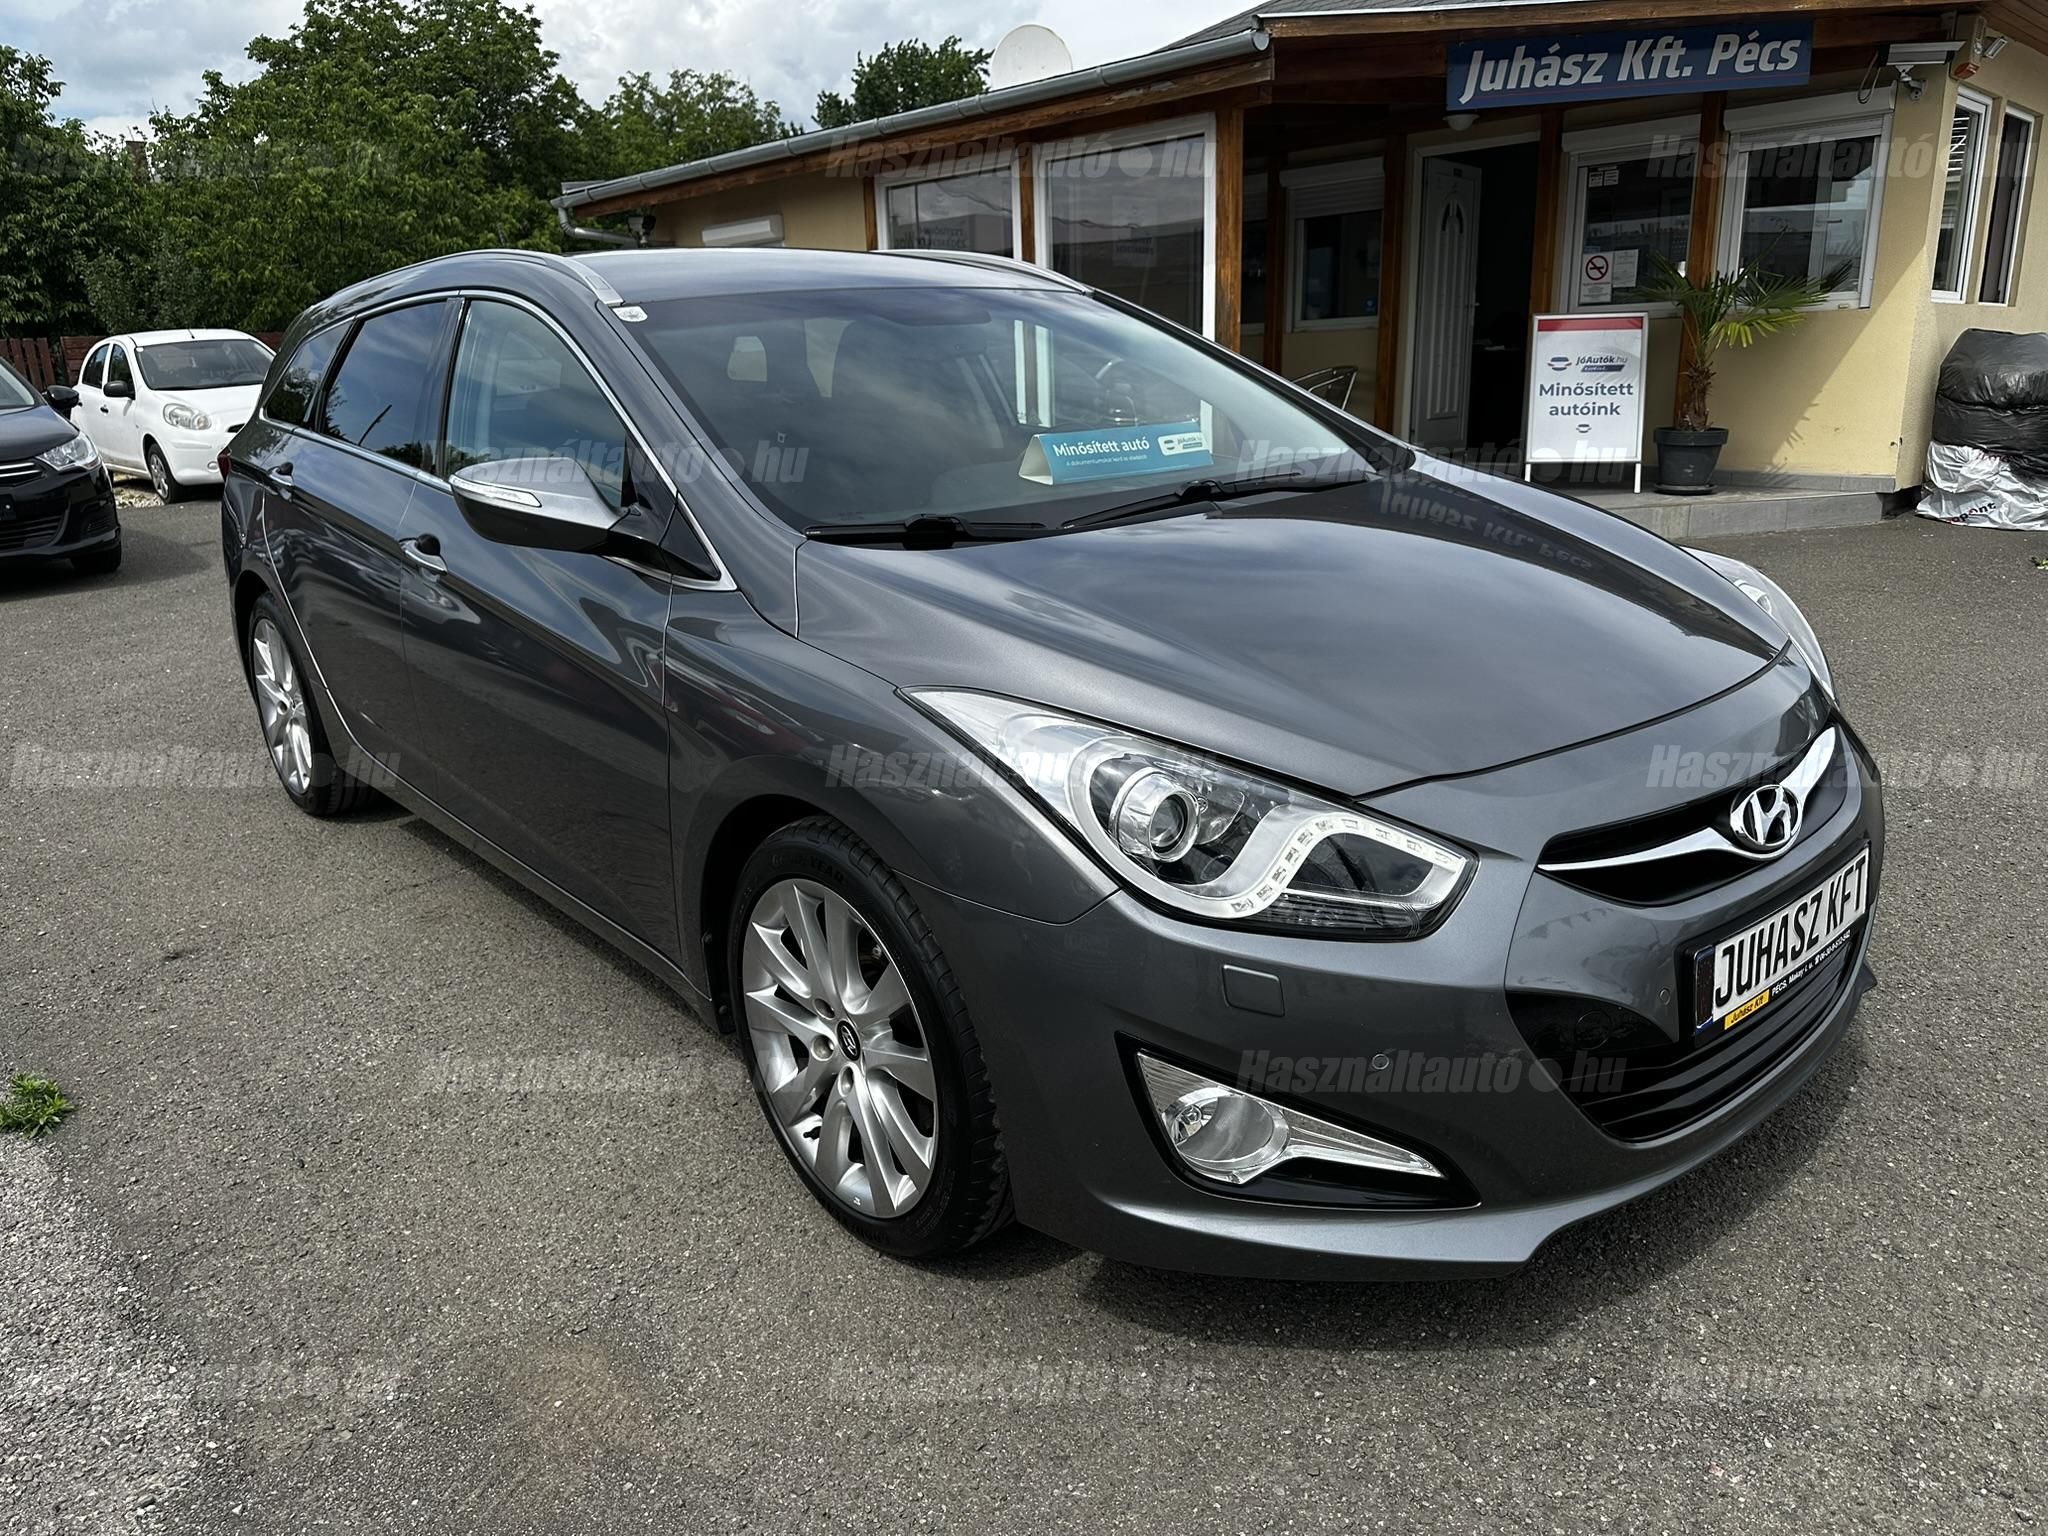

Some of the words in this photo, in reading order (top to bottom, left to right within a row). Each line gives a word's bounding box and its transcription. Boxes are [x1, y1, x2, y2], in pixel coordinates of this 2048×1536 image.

[1459, 43, 1608, 104] Juhász
[1617, 35, 1693, 81] Kft.
[1707, 30, 1802, 75] Pécs
[1539, 382, 1634, 397] Minősített
[1549, 402, 1621, 416] autóink
[1052, 441, 1120, 457] Minősített
[1121, 436, 1150, 451] autó
[1715, 890, 1823, 1007] JUHASZ
[1826, 854, 1866, 936] KFT
